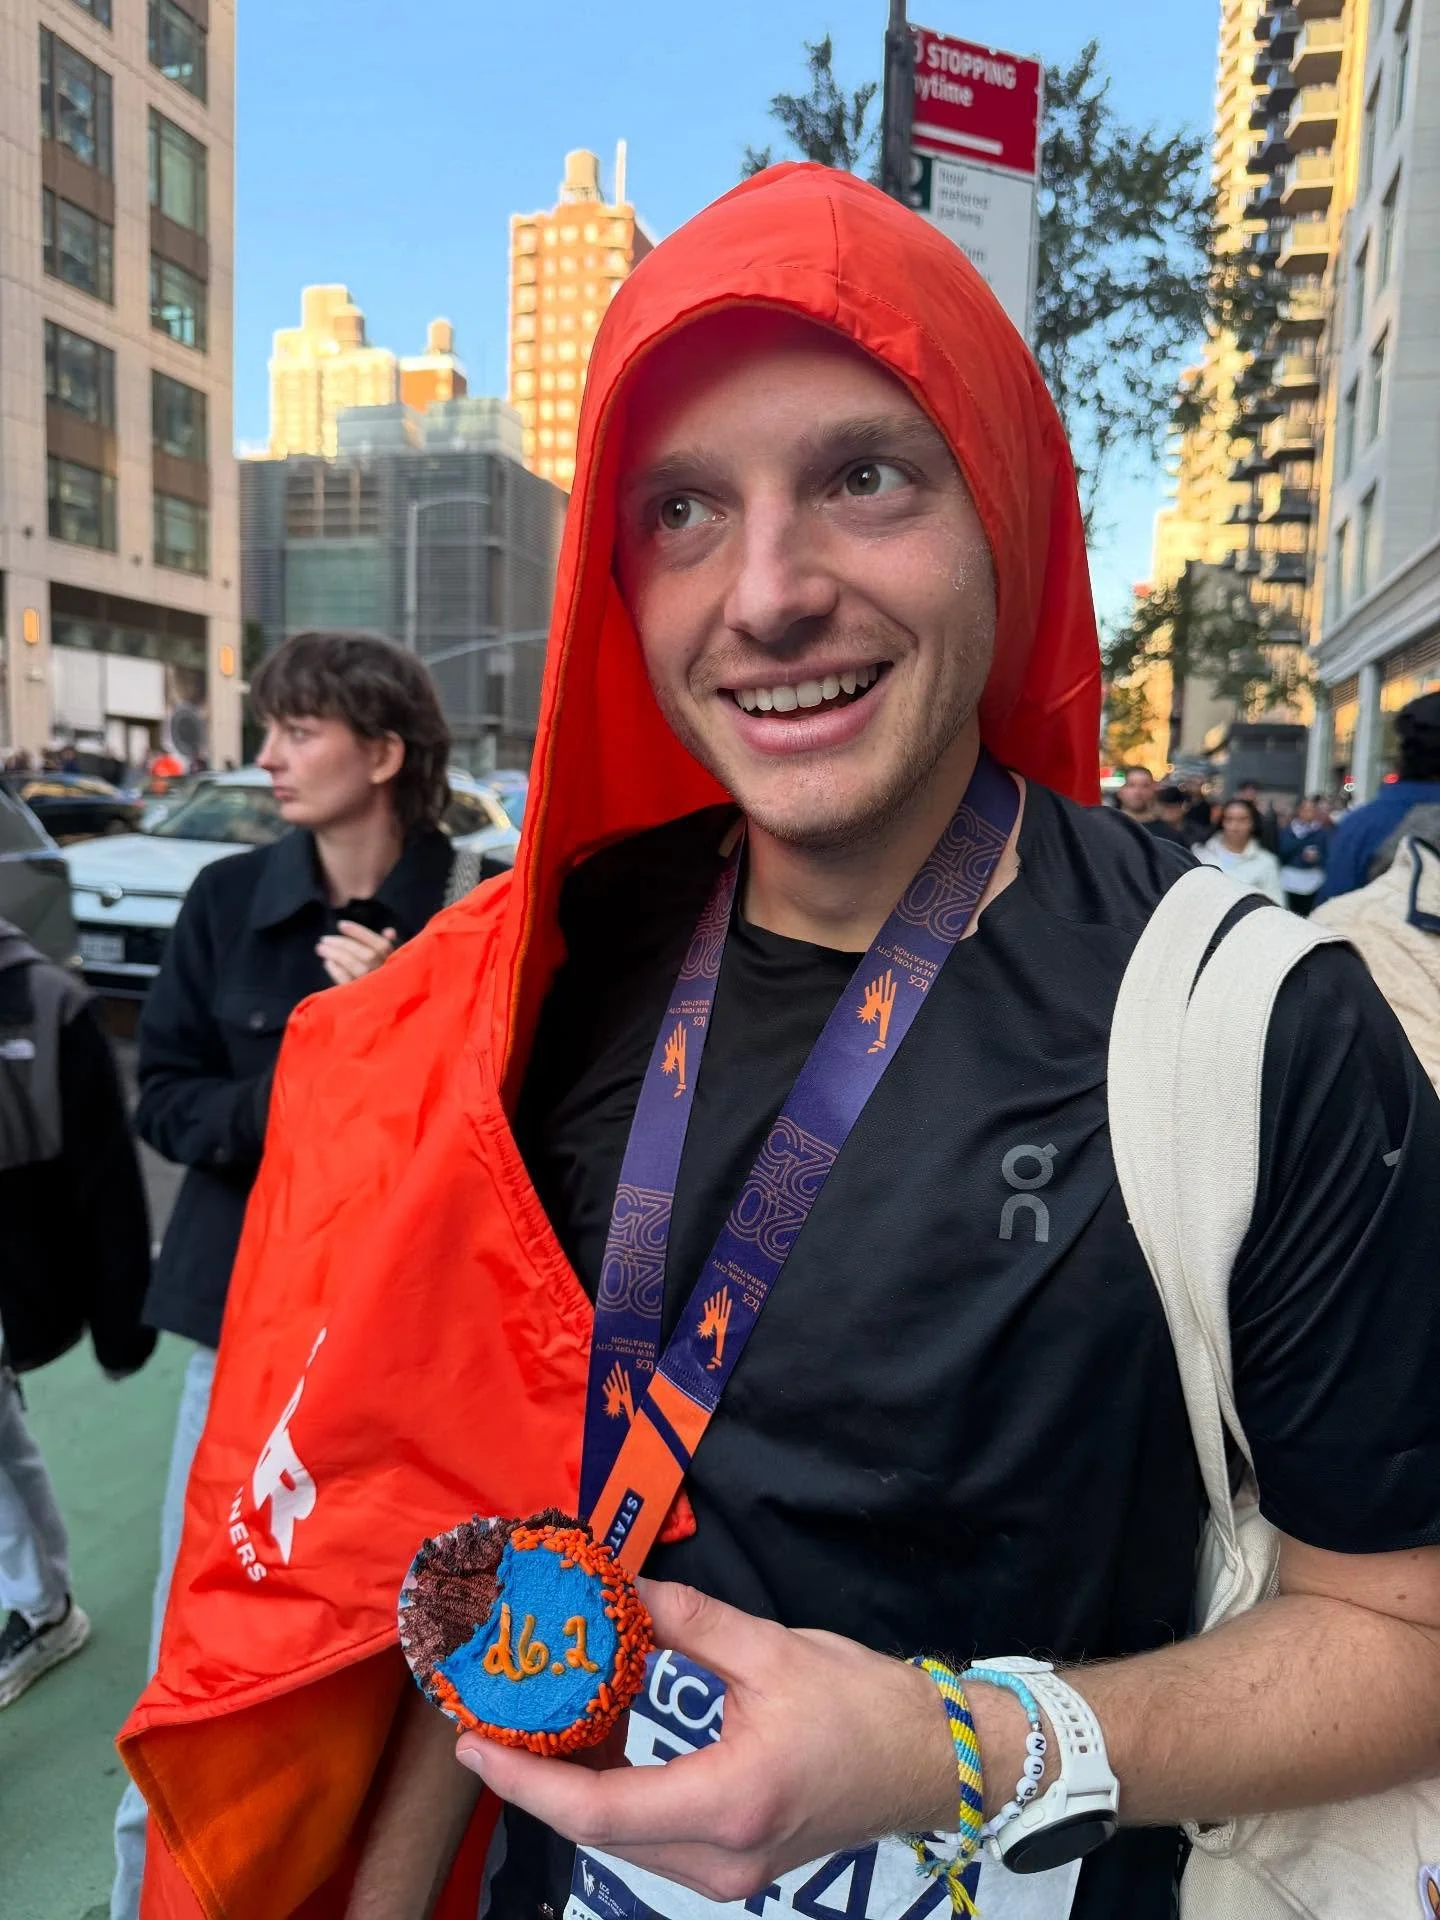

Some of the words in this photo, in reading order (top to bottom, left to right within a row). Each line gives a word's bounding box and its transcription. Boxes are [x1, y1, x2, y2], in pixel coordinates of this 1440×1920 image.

[926, 41, 1017, 90] STOPPING
[913, 72, 974, 108] nytime
[875, 945, 893, 958] CITY
[893, 944, 938, 970] MARATHON
[893, 955, 913, 970] YORK
[914, 967, 935, 978] NEW
[228, 1486, 268, 1582] NERS
[608, 1496, 639, 1560] STAT
[1024, 1738, 1046, 1797] RUN
